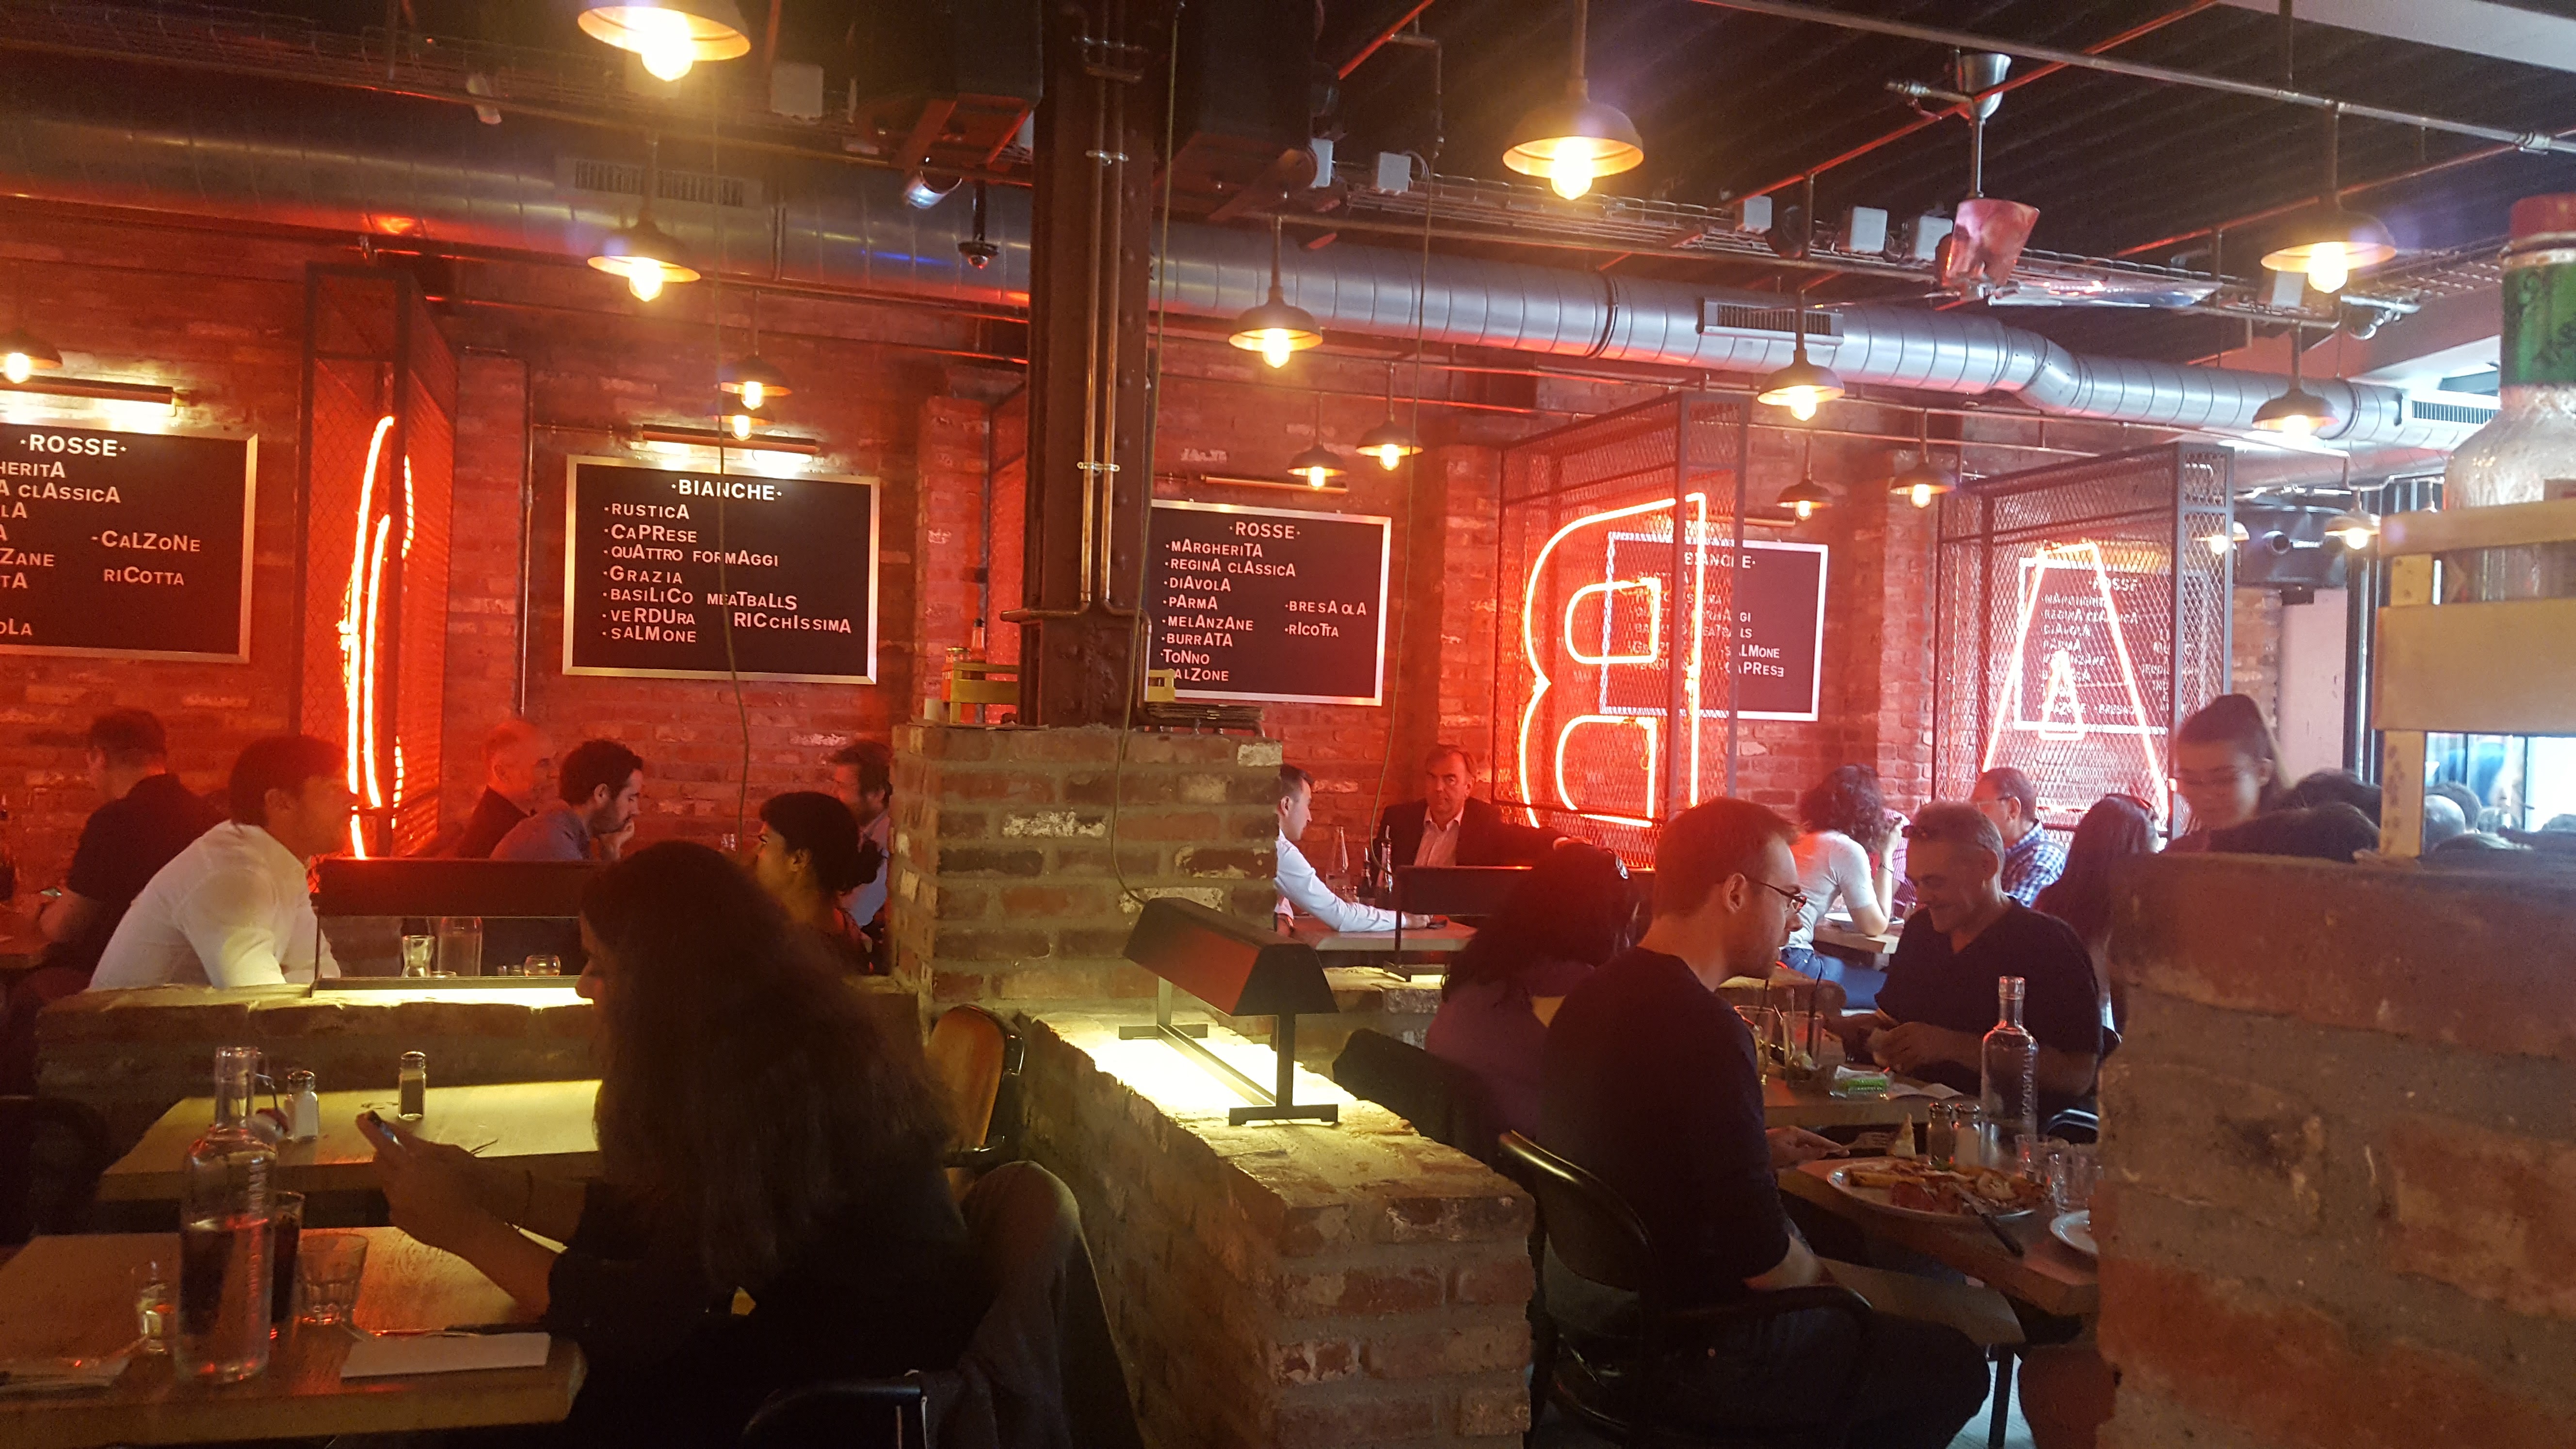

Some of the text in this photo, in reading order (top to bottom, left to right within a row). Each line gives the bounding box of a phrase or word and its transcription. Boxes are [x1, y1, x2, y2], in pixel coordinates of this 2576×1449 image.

[30, 434, 118, 457] ROSSE
[18, 482, 121, 503] CLASSICA
[678, 479, 775, 501] BIANCHE
[612, 503, 690, 520] RUSTICA
[611, 524, 697, 543] CAPRESE
[1235, 521, 1295, 540] ROSSE
[101, 530, 201, 552] CALZONE
[1171, 538, 1263, 558] MARGHERITA
[611, 544, 684, 562] QUATTRO
[104, 566, 184, 586] RICOTTA
[610, 565, 683, 584] GRAZIA
[1170, 558, 1296, 577] REGINA CLASSICA
[1169, 575, 1232, 592] DIAVOLA
[610, 587, 693, 604] BASILICO
[1169, 594, 1218, 610] PARMA
[610, 607, 852, 633] VERDURA RICCHISSIMA
[1167, 614, 1254, 631] MELANZANE
[611, 626, 697, 643] SALMONE
[1288, 622, 1339, 638] RICOTTA
[1166, 632, 1233, 647] BURRATA
[1162, 648, 1210, 665] TONNO
[1174, 667, 1229, 682] ALZONE
